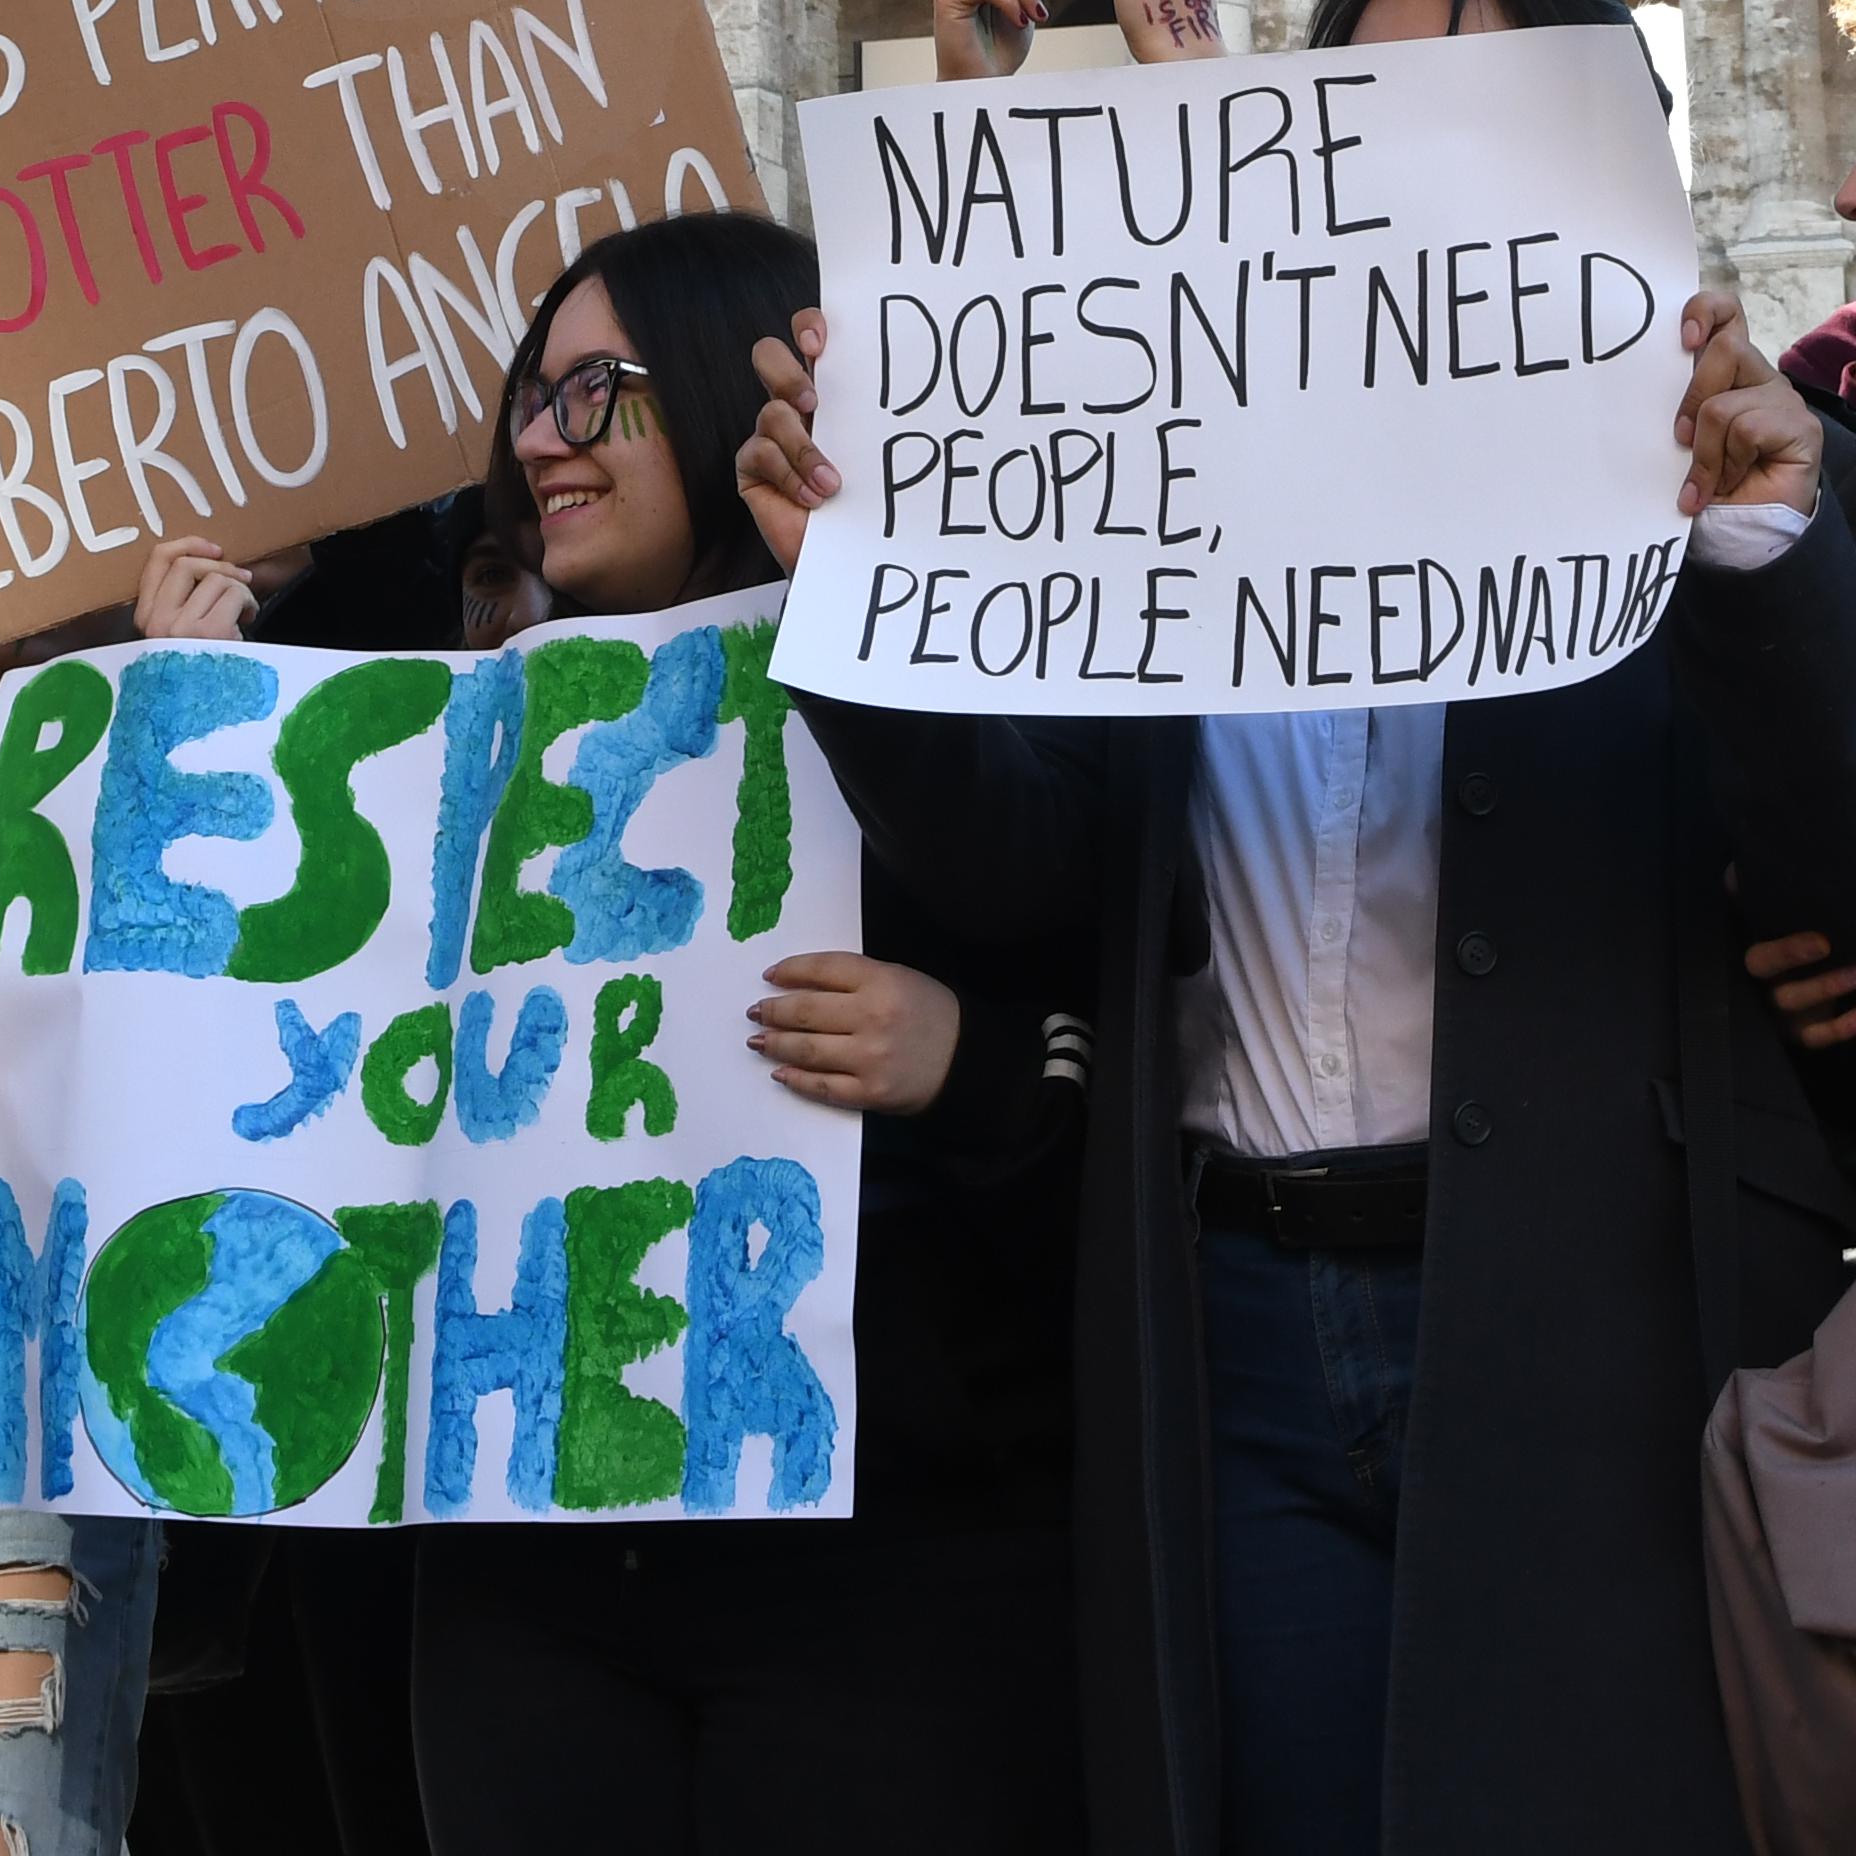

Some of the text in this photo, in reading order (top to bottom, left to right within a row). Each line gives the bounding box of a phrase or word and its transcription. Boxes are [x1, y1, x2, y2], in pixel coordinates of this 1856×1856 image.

[1168, 9, 1222, 49] FIR
[873, 73, 1392, 267] NATURE
[880, 232, 1657, 416] DOESN'T NEED
[882, 419, 1223, 553] PEOPLE,
[858, 563, 1198, 685] PEOPLE
[231, 972, 678, 1146] YOUR
